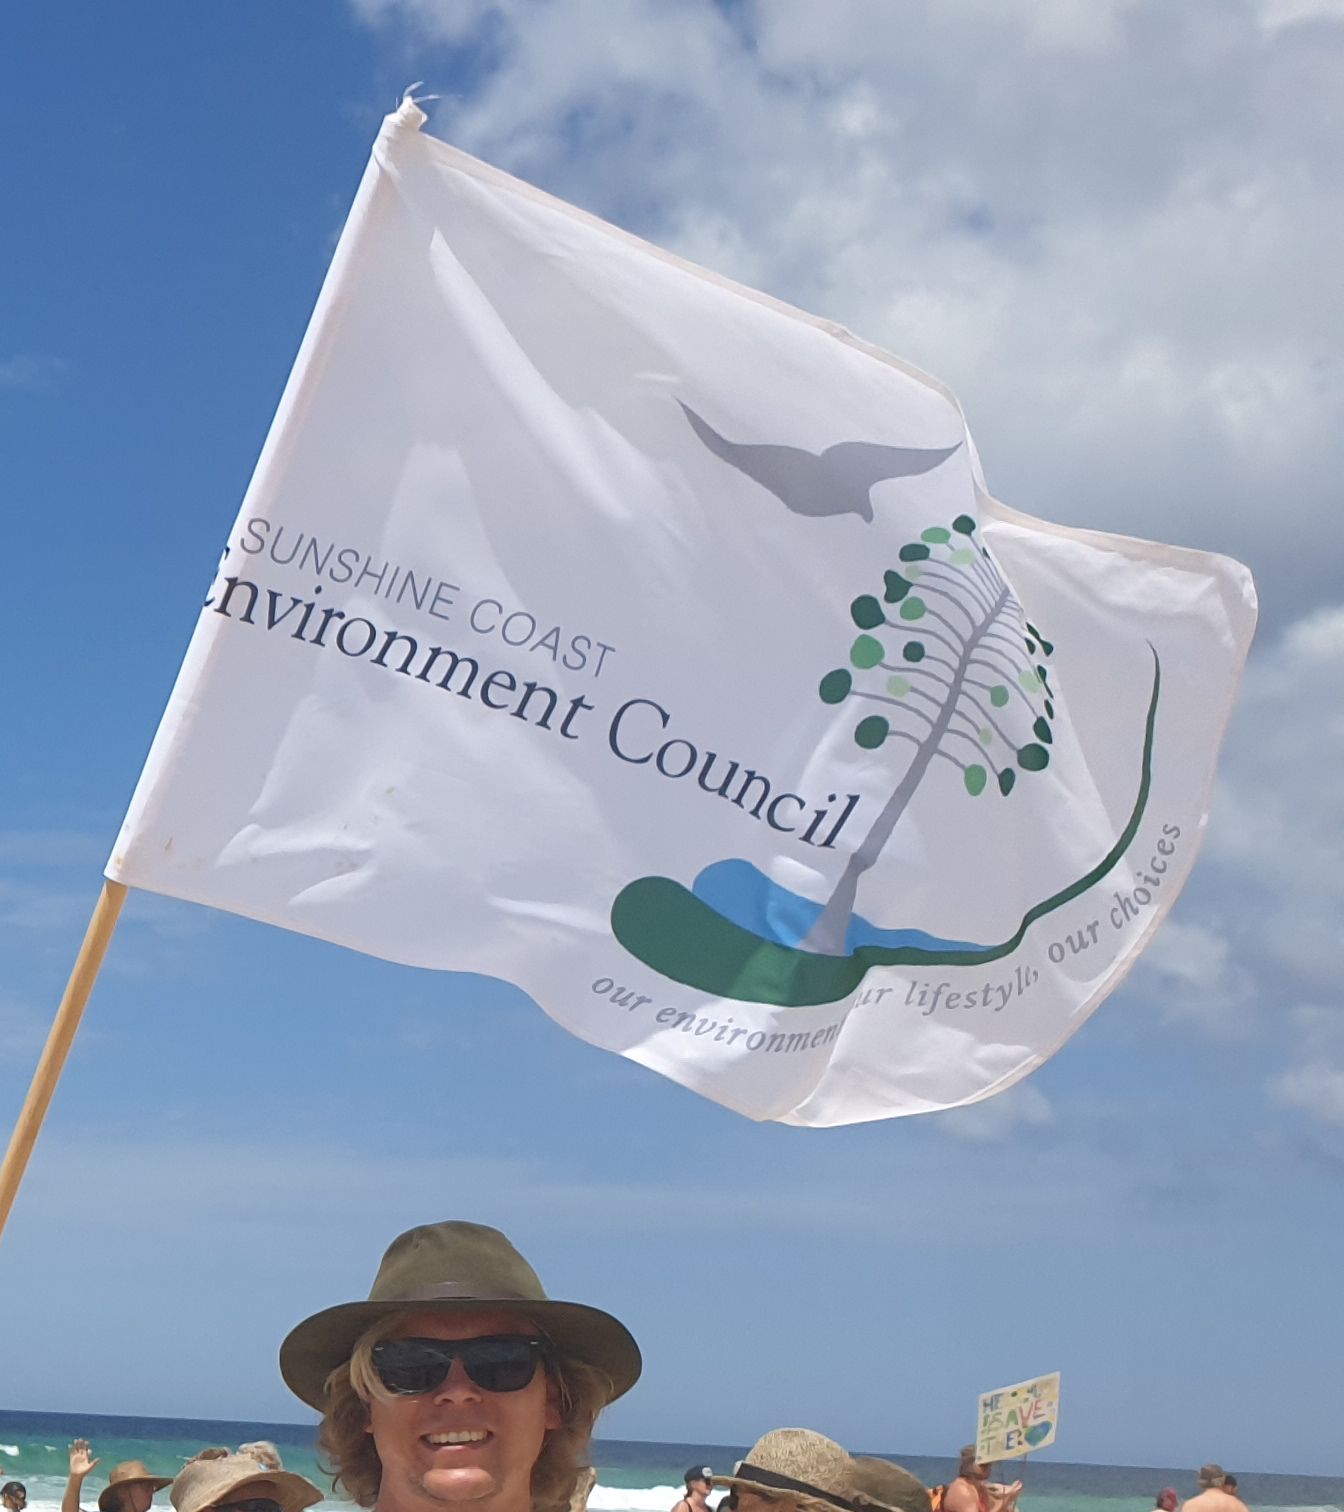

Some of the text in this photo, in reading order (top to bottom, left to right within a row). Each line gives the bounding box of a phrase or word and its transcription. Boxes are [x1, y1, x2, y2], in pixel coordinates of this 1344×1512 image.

[204, 548, 860, 850] nvironment Council
[240, 517, 616, 679] SUNSHINE COAST
[591, 977, 653, 1012] our
[655, 1006, 846, 1053] environmen
[855, 986, 894, 1009] ur
[1048, 919, 1099, 964] our
[1110, 823, 1181, 929] choices
